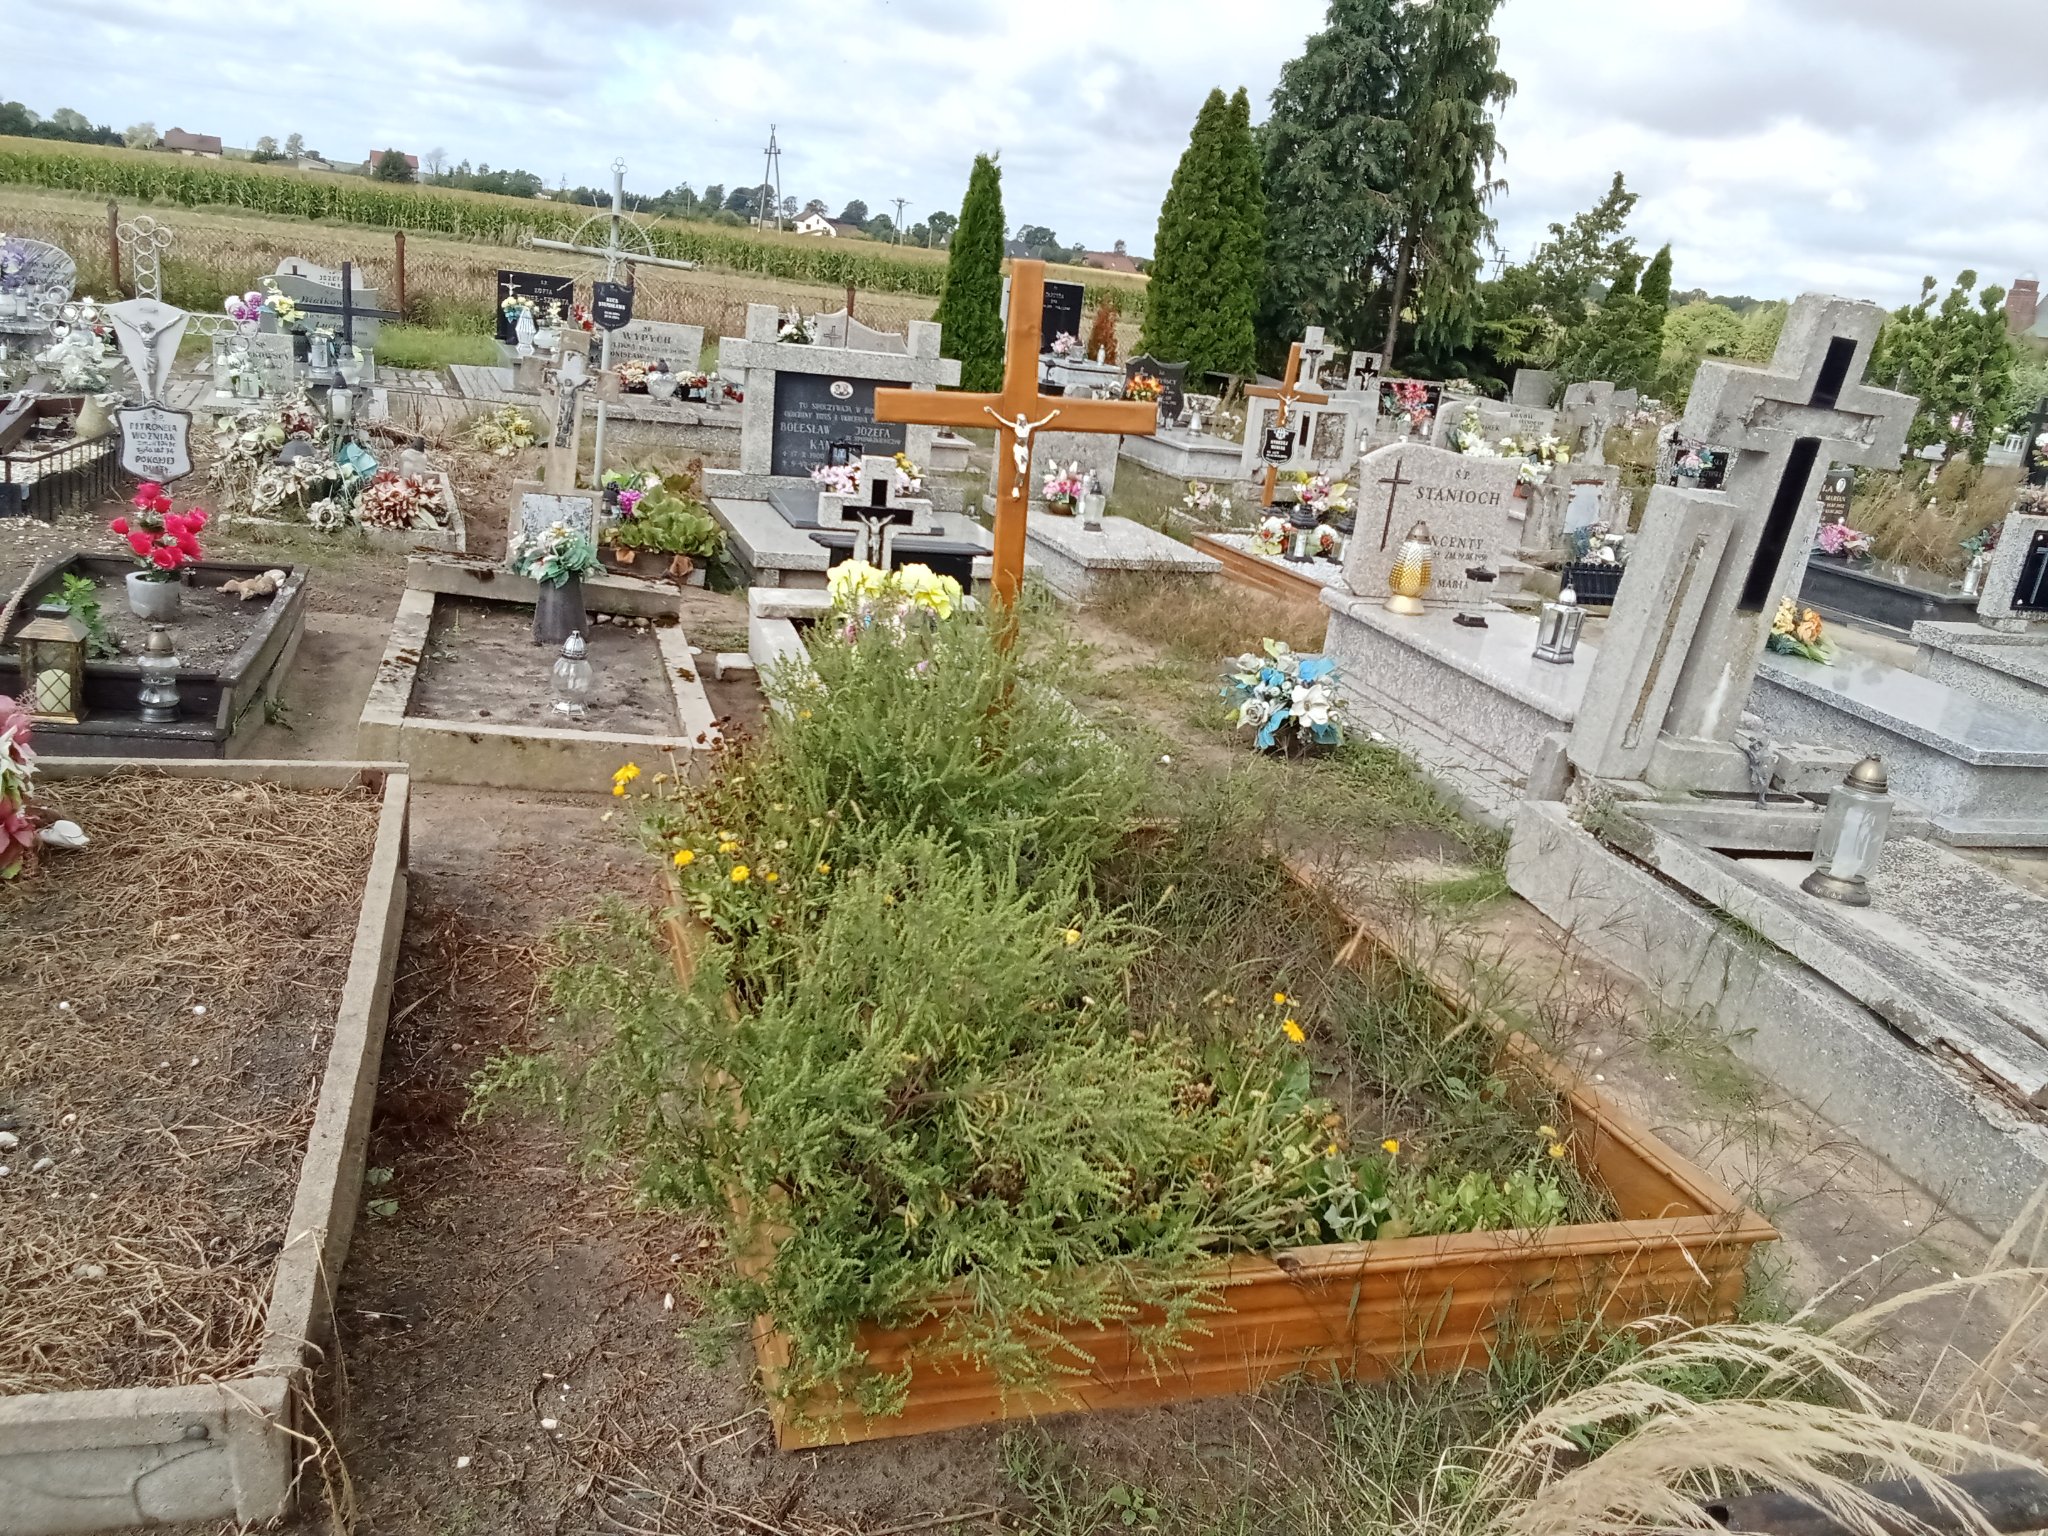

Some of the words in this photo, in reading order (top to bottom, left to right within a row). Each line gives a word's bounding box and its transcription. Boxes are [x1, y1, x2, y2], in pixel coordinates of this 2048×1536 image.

[622, 331, 672, 344] WYPYCH
[129, 422, 177, 432] PETRONELA
[780, 422, 832, 435] BOLESŁAW
[1416, 486, 1501, 506] STANIOCH
[1430, 535, 1484, 550] NCENTY
[1437, 579, 1469, 589] MARIA
